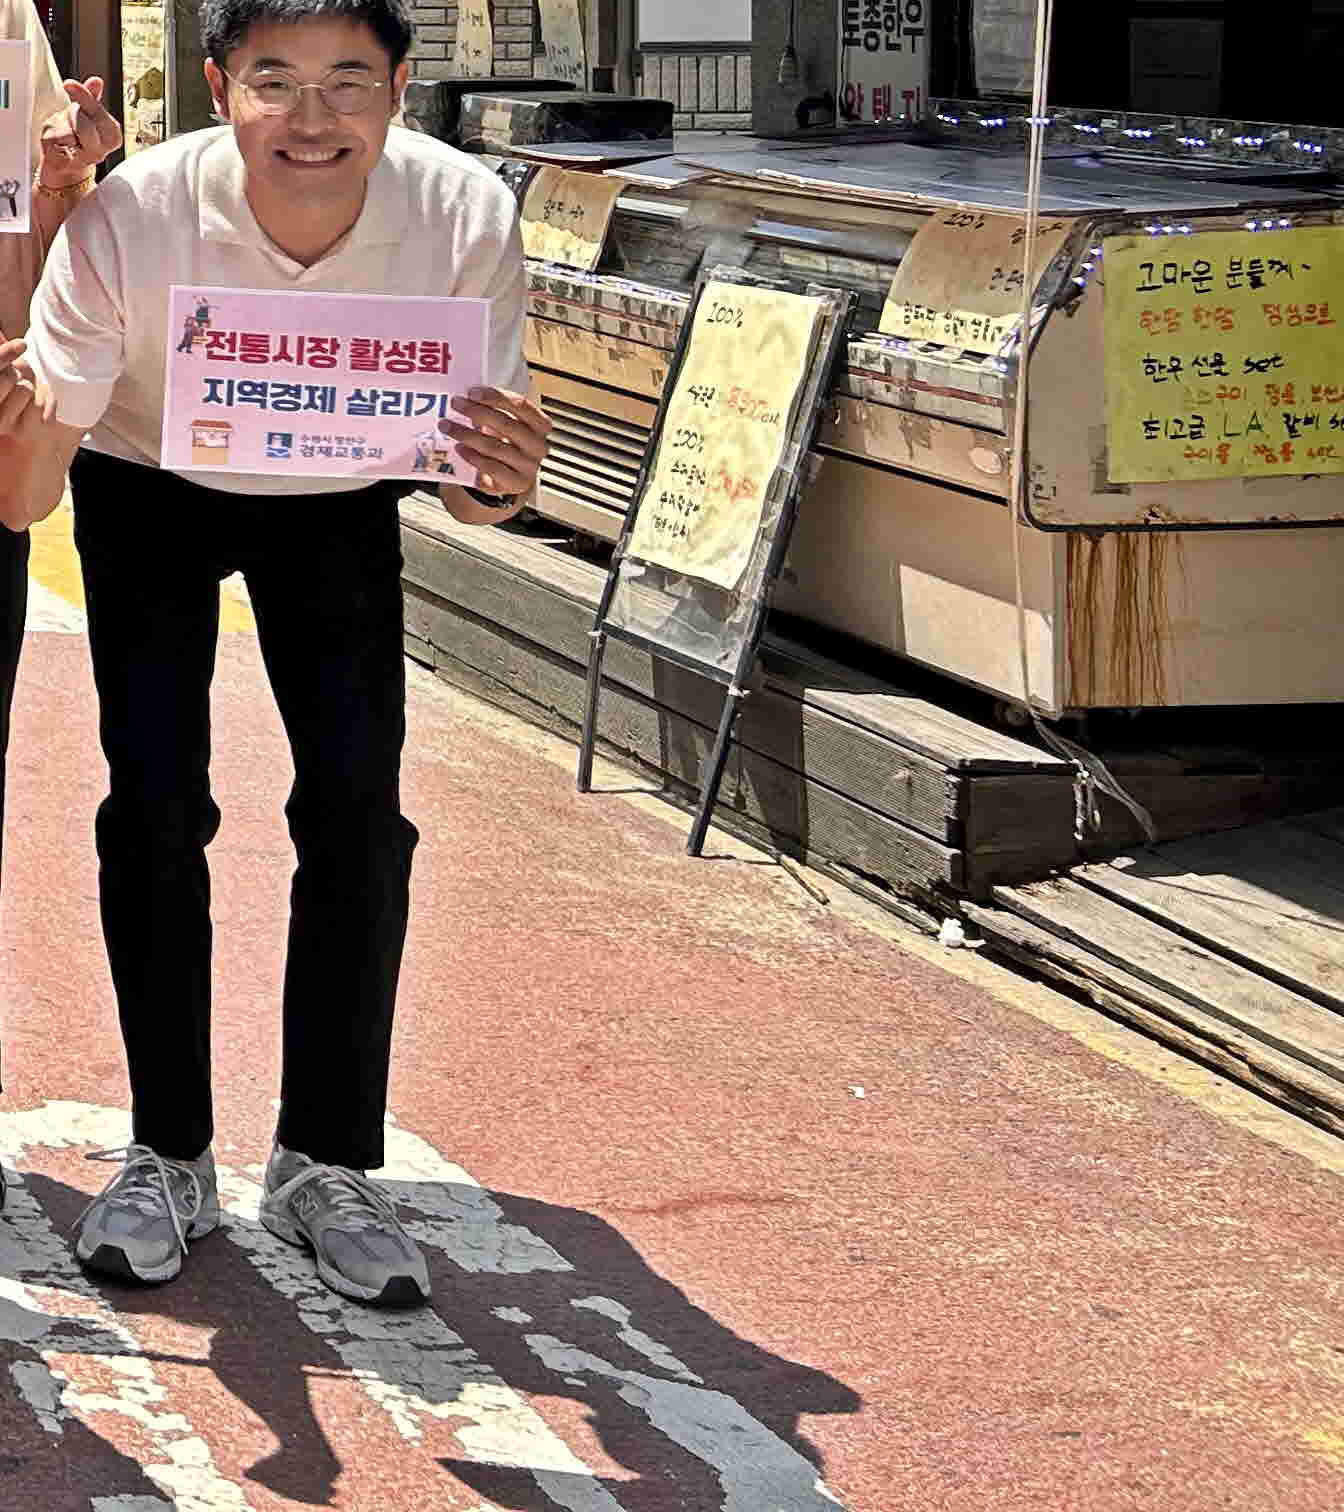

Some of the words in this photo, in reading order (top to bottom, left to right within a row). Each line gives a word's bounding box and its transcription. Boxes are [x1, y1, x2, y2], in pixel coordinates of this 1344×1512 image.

[1135, 258, 1213, 294] 고마운
[205, 330, 340, 369] 전통시장
[349, 337, 452, 375] 활성화
[1142, 352, 1184, 383] 한우
[1191, 352, 1231, 377] 선물
[202, 378, 337, 413] 지역경제
[346, 389, 448, 418] 살리기
[1142, 410, 1207, 440] 최고급
[1223, 410, 1265, 437] LA
